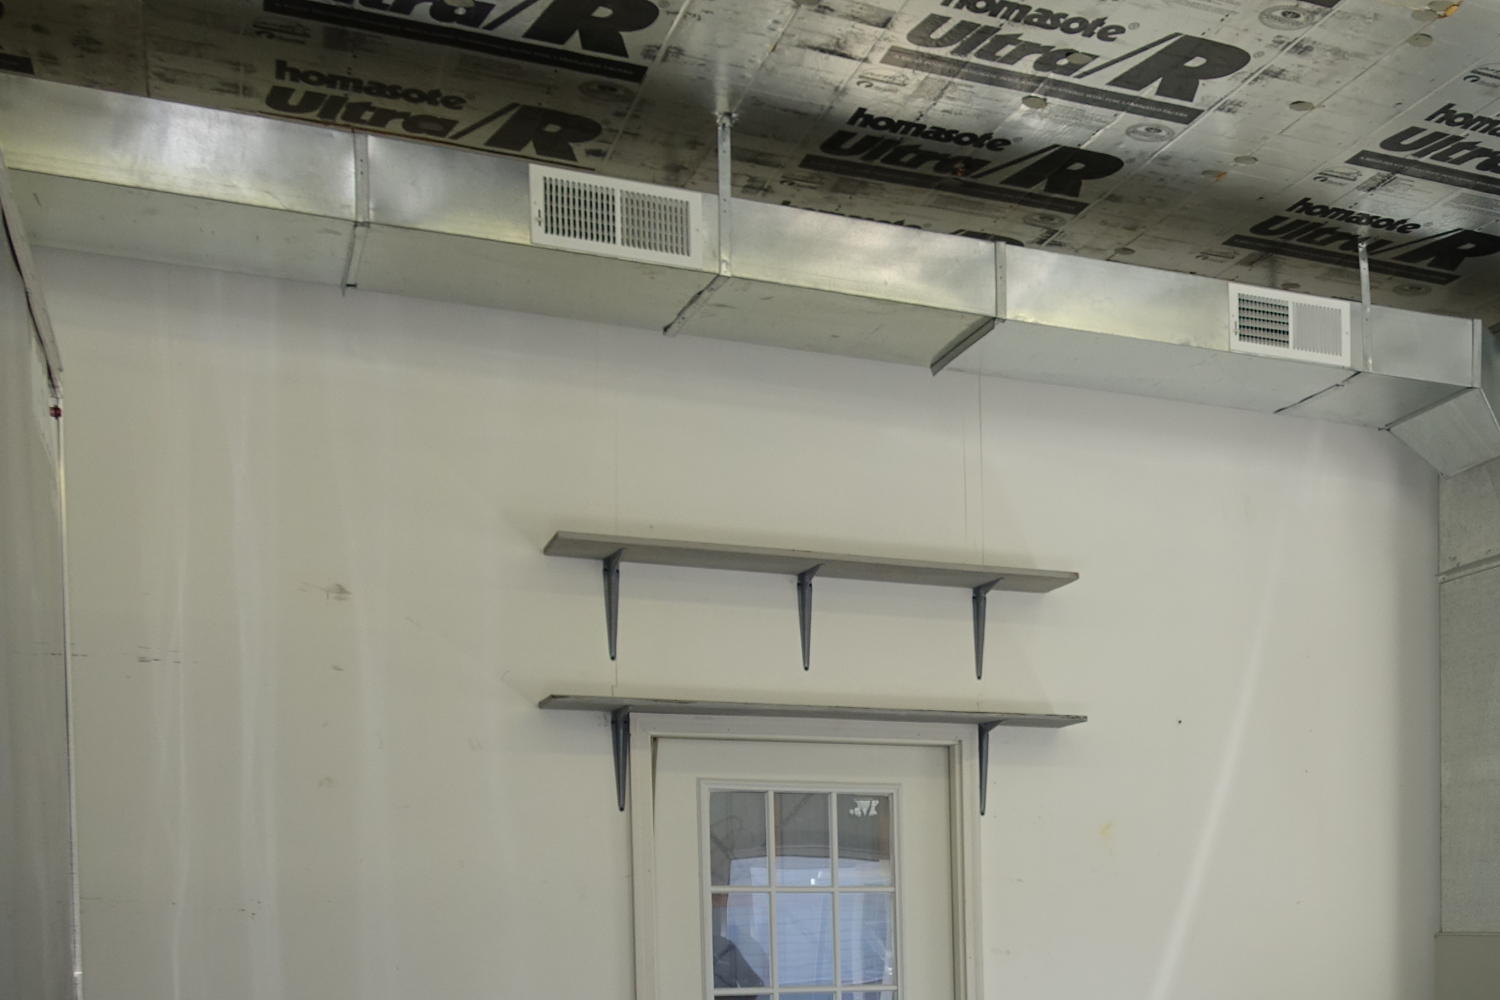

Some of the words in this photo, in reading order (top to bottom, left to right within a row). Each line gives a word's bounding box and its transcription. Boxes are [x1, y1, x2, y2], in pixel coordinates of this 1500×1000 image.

[275, 60, 467, 110] homasote
[906, 13, 1251, 102] Ultra/R
[265, 86, 602, 162] Ultra/R
[847, 107, 1012, 151] homasote
[820, 130, 1124, 197] Ultra/R
[1286, 197, 1421, 234] homasote
